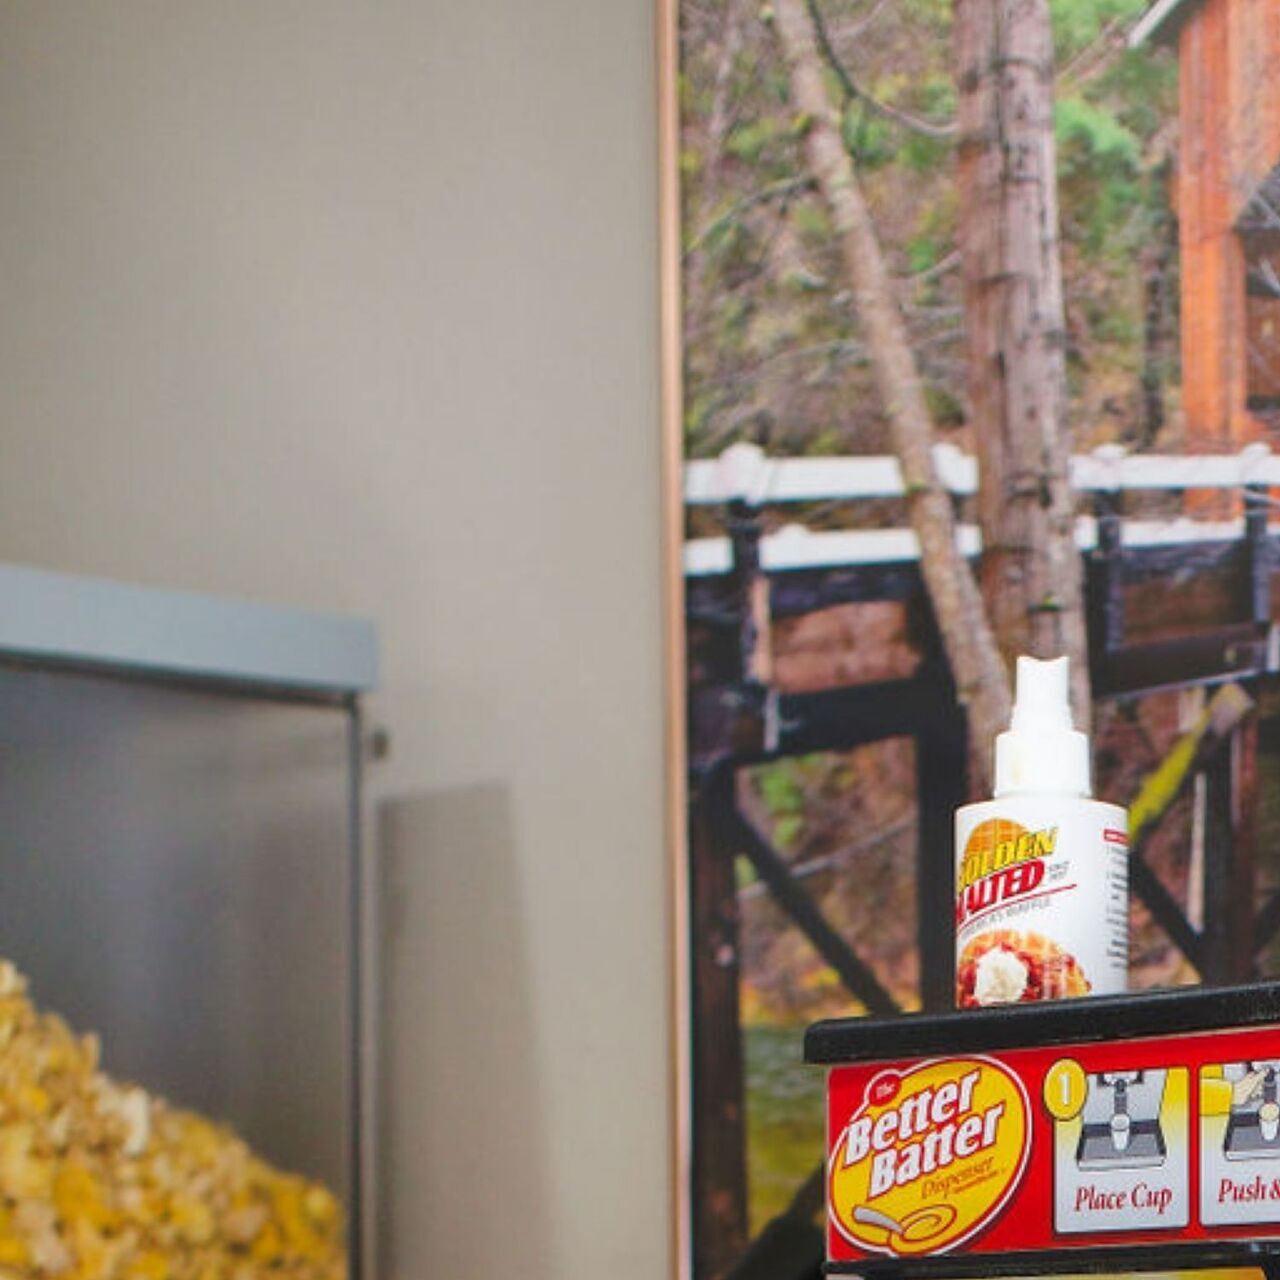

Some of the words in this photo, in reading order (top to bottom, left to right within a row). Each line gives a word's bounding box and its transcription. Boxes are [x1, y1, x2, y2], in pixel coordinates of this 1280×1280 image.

[1058, 1072, 1070, 1106] 1
[843, 1068, 982, 1168] Better
[868, 1102, 1005, 1200] Batter
[1074, 1186, 1126, 1213] Place
[1131, 1182, 1173, 1214] Cup
[1218, 1175, 1267, 1203] Push
